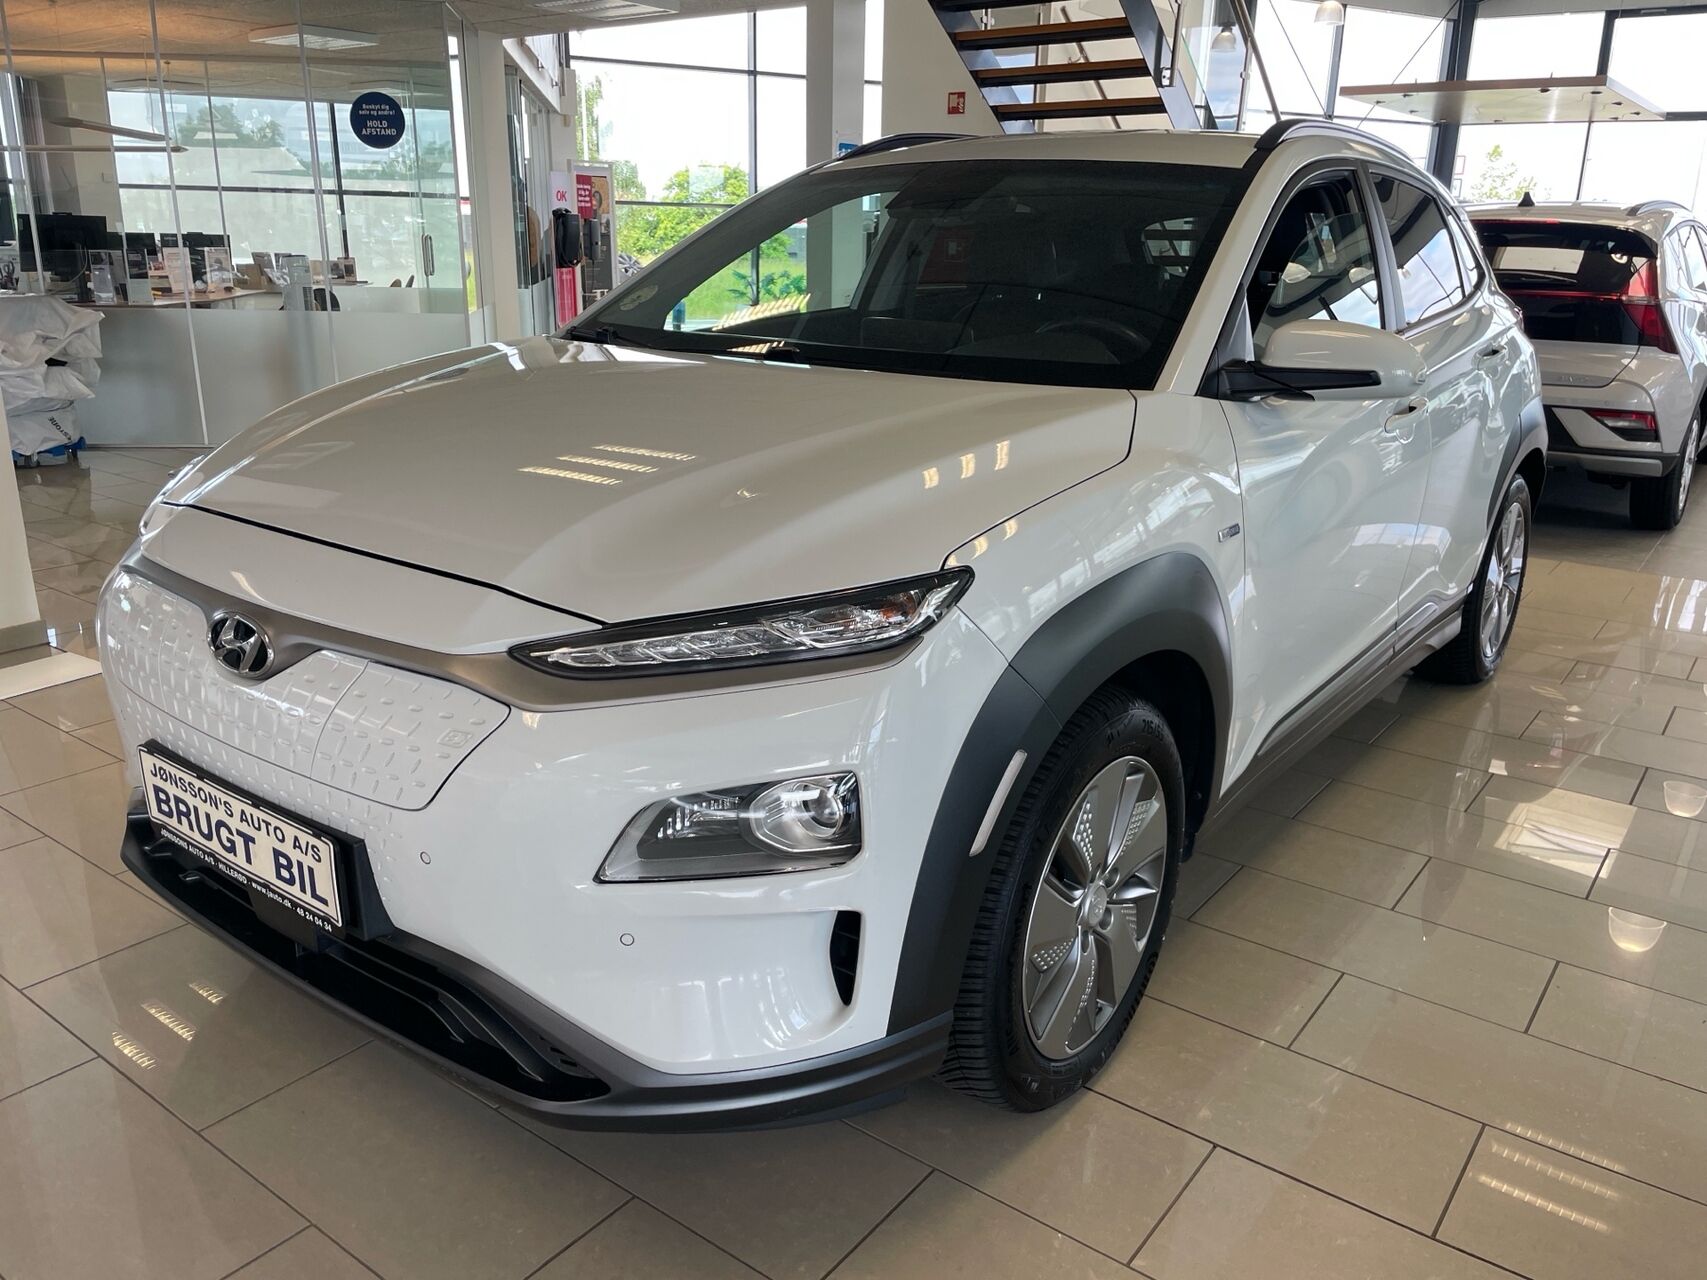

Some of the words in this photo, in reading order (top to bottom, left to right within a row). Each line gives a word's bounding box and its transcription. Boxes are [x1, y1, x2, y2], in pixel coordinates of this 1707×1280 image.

[556, 190, 567, 202] OK
[150, 763, 234, 818] JØNSSON'S
[240, 808, 285, 843] AUTO
[293, 835, 322, 863] A/S
[152, 784, 256, 866] BRUGT
[272, 846, 329, 907] BIL
[189, 844, 204, 859] AUTO
[204, 853, 215, 865] A/S
[296, 907, 305, 917] 48
[305, 911, 314, 922] 24
[314, 916, 323, 927] 04
